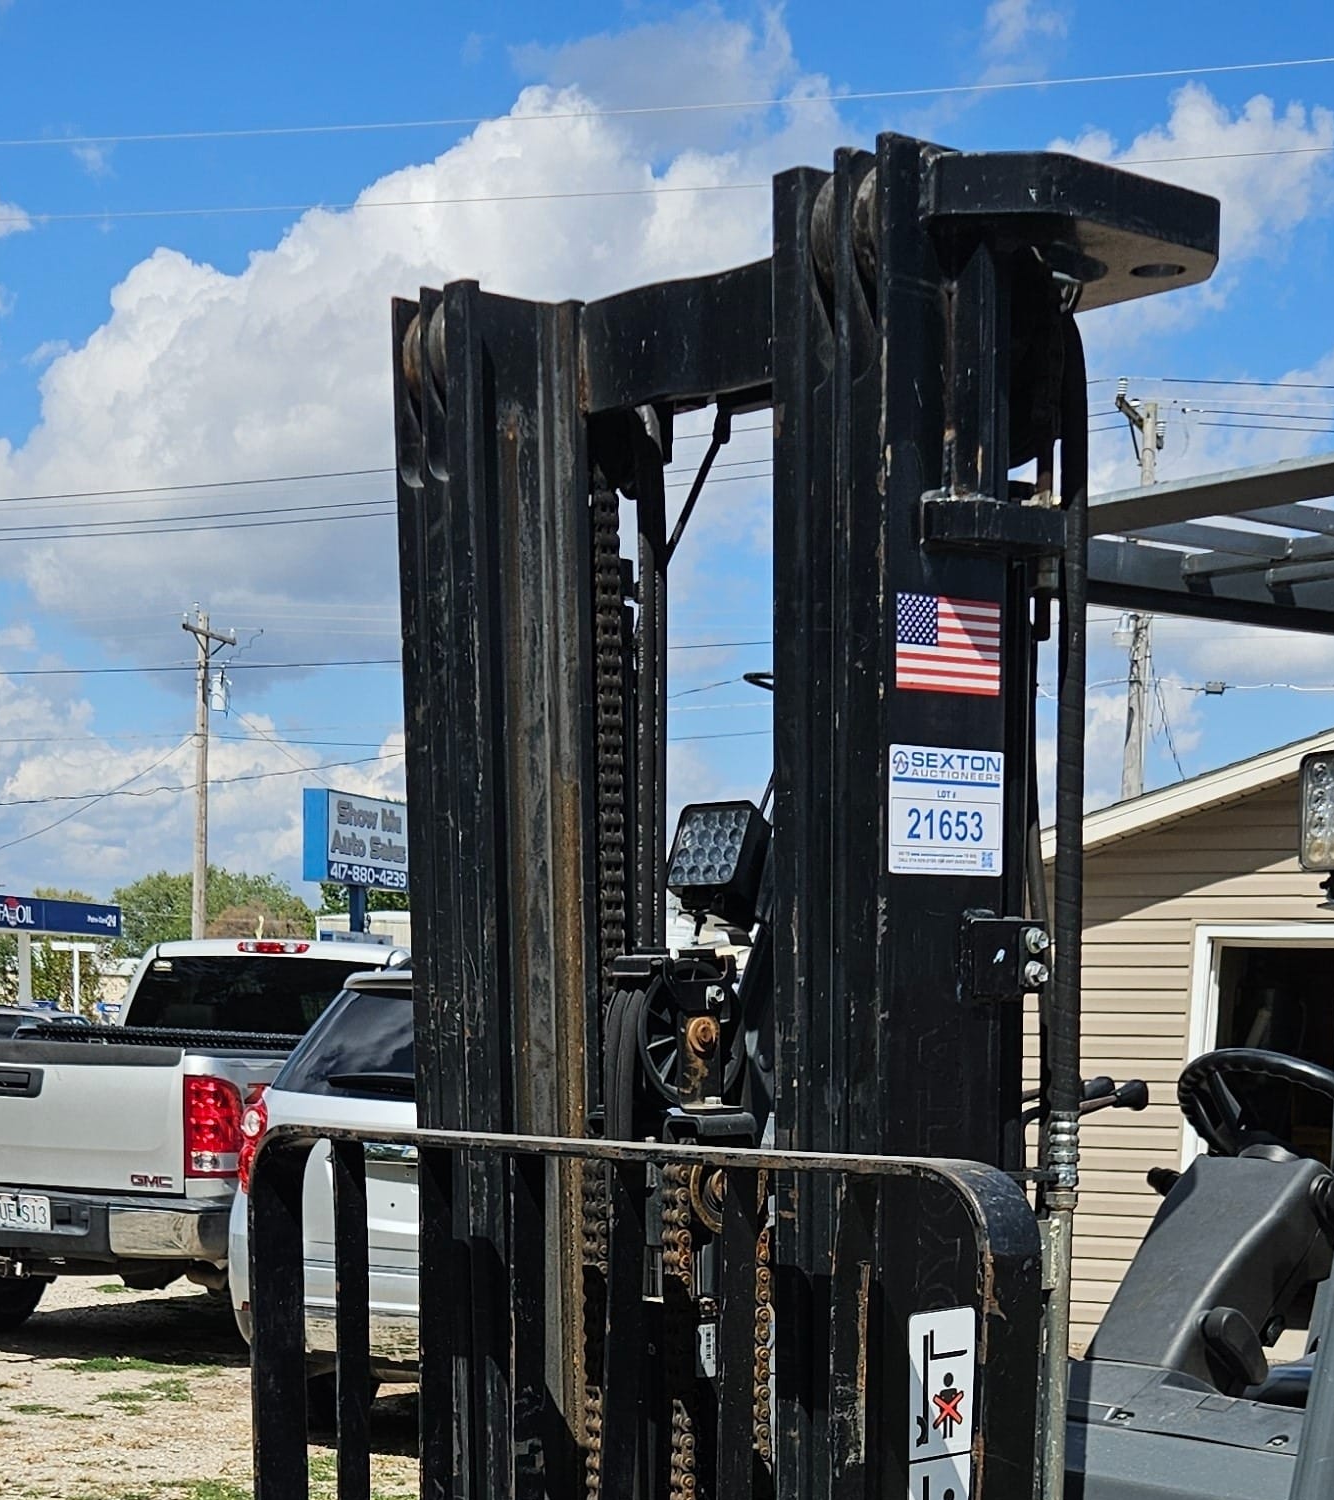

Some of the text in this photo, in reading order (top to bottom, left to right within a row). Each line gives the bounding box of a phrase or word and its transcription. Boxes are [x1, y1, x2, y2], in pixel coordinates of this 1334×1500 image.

[911, 752, 1001, 772] SEXTON
[911, 768, 1001, 782] AUCTIONEERS
[937, 790, 951, 799] LOT
[337, 800, 379, 830] Show
[907, 808, 983, 842] 21653
[331, 830, 407, 864] Auto Sales
[330, 863, 407, 888] 417-880-4239
[16, 904, 35, 925] OIL
[130, 1174, 173, 1188] GMC
